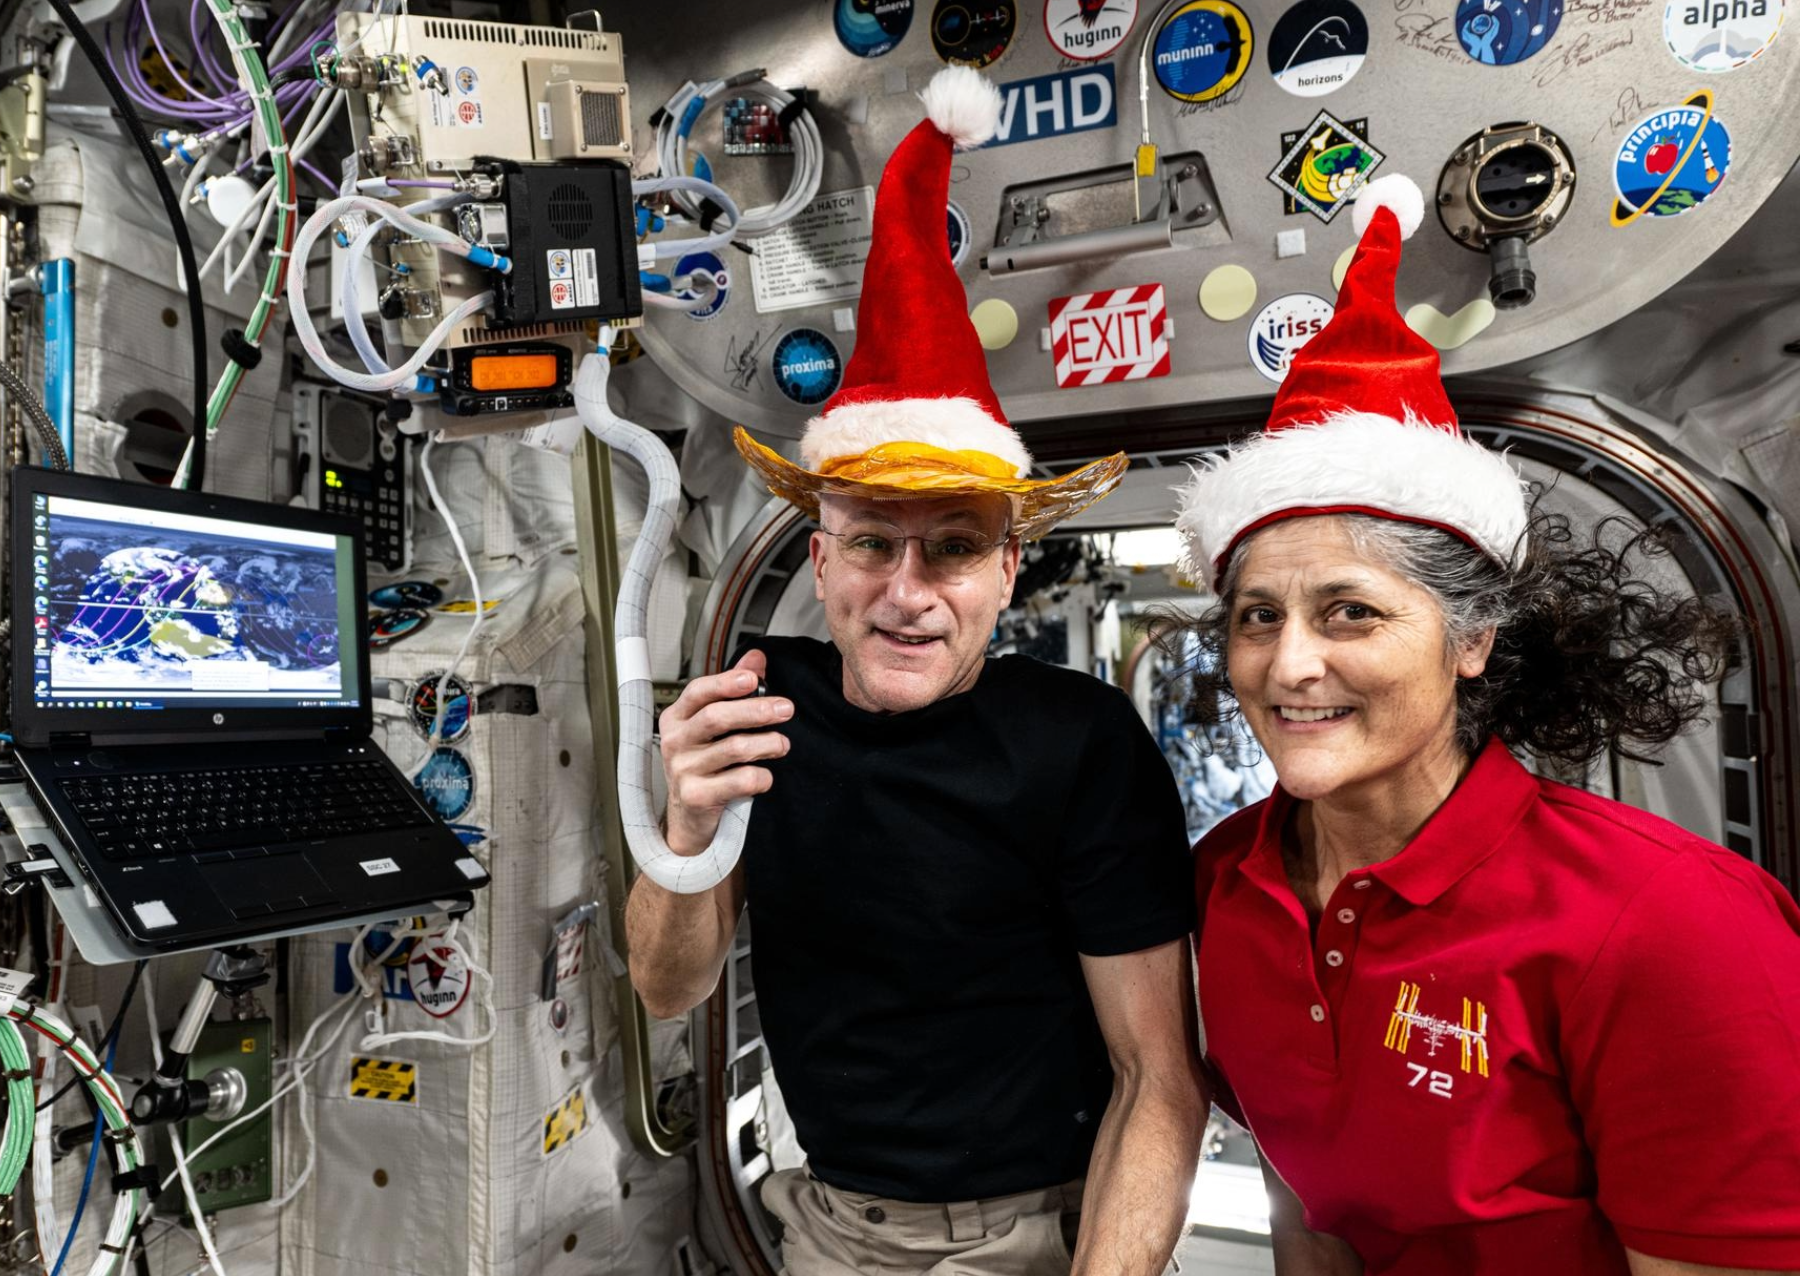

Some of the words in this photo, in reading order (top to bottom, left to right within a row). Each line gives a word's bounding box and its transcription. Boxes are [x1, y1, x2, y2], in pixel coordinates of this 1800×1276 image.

[875, 0, 911, 14] minerva
[1683, 0, 1767, 29] alpha
[1064, 26, 1121, 48] huginn
[1157, 43, 1214, 65] muninn
[1298, 73, 1343, 87] horizons
[994, 72, 1113, 141] VHD
[1619, 111, 1702, 163] principia
[817, 196, 855, 212] HATCH
[1069, 309, 1147, 365] EXIT
[1268, 316, 1323, 340] iriss
[781, 357, 836, 379] proxima
[422, 775, 470, 791] proxima
[420, 991, 457, 1007] huginn
[1406, 1061, 1454, 1099] 72
